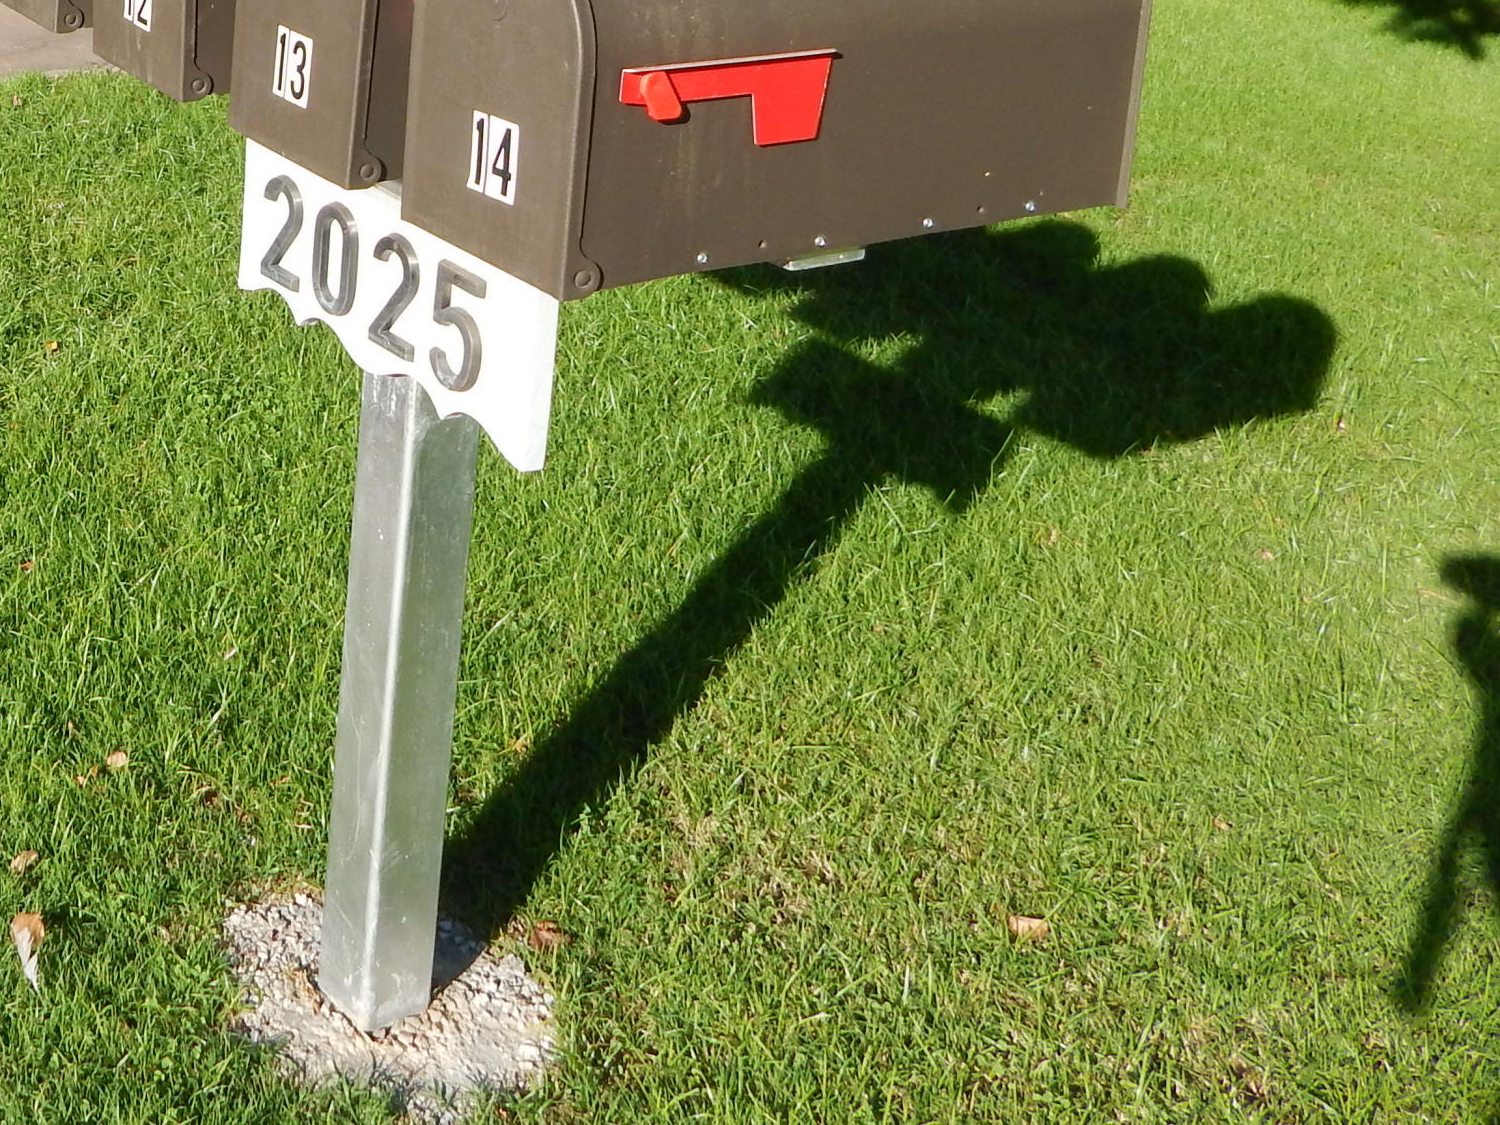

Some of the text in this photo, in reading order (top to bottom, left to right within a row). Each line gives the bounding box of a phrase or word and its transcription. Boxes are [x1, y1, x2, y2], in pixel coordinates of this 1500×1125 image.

[276, 32, 307, 100] 13
[474, 117, 512, 197] 14
[260, 174, 488, 392] 2025
